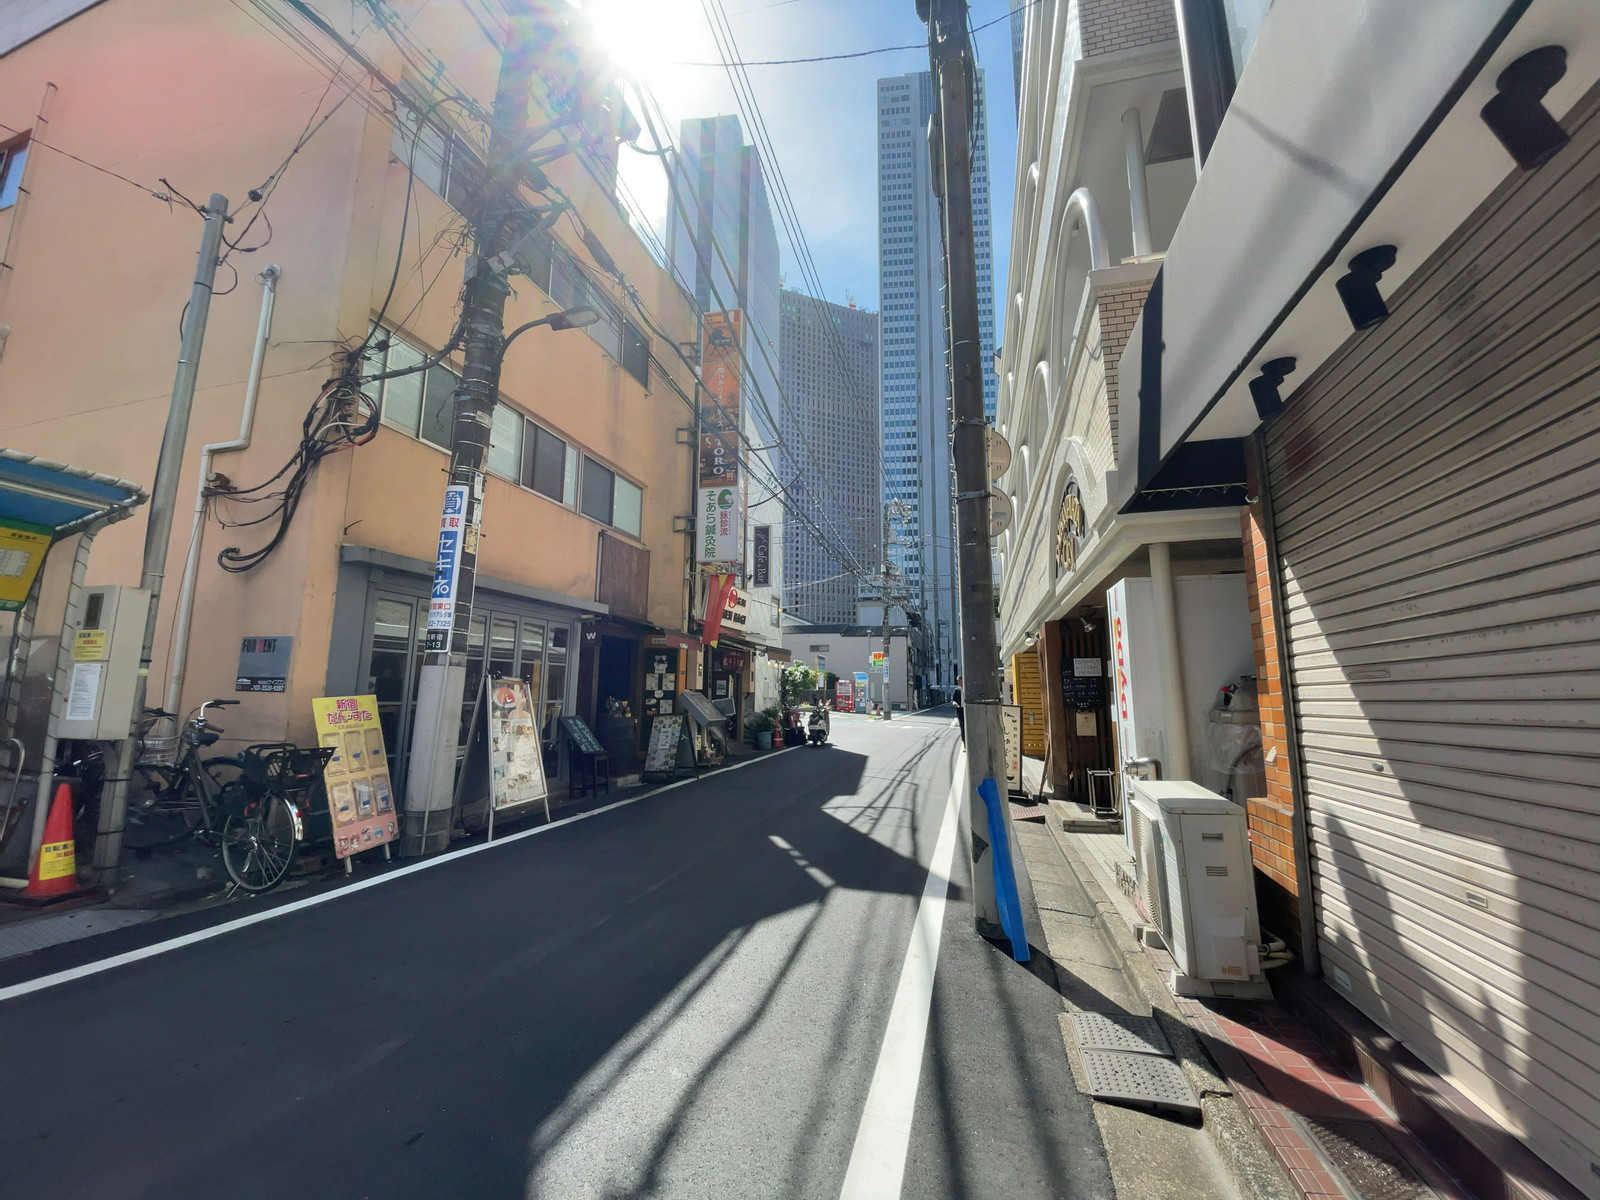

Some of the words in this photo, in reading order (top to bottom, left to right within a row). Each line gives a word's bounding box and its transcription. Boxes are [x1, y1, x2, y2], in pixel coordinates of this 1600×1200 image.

[704, 490, 716, 559] そあら鍼灸院
[432, 533, 454, 595] セキネ
[757, 568, 767, 582] Bar
[585, 632, 597, 640] W
[242, 639, 257, 653] FOR
[258, 639, 277, 653] RENT
[336, 698, 358, 711] 新宿
